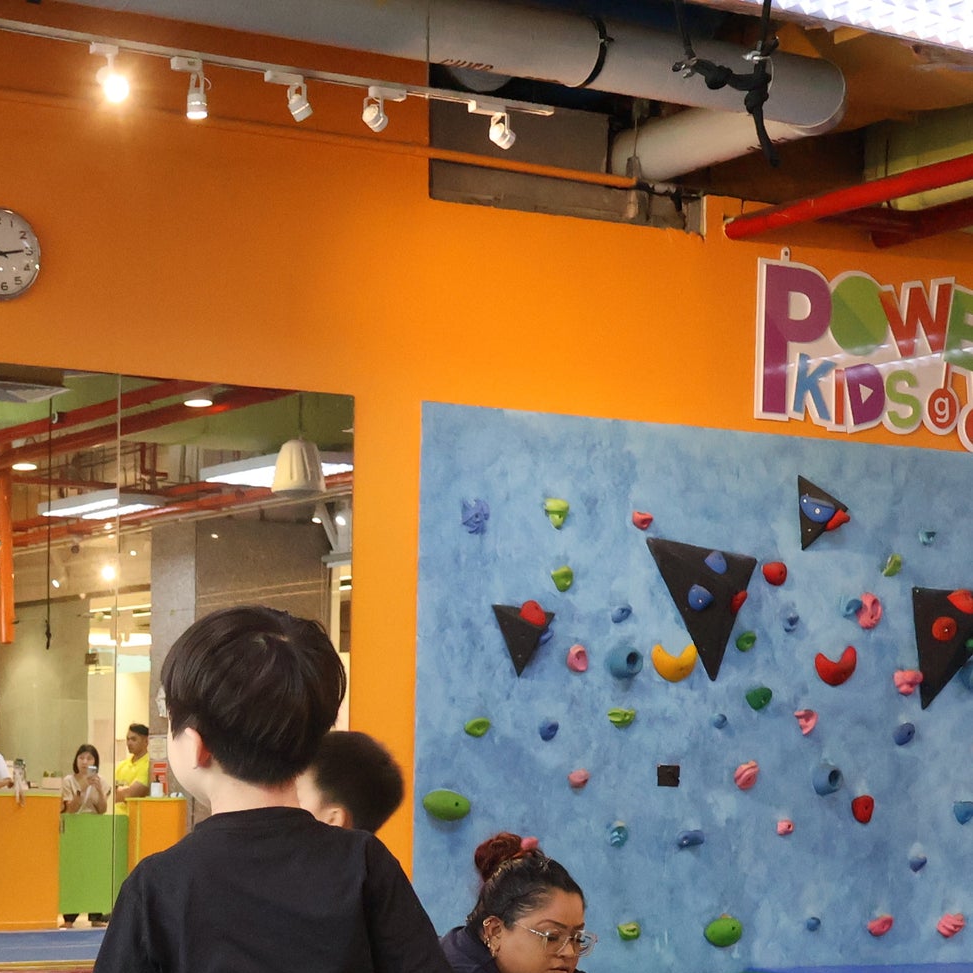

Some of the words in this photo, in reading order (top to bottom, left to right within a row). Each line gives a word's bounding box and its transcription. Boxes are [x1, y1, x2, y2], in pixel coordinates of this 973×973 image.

[19, 230, 27, 240] 2
[23, 263, 31, 271] 4
[14, 276, 23, 285] 5
[0, 282, 9, 291] 6
[793, 352, 922, 428] KIDS
